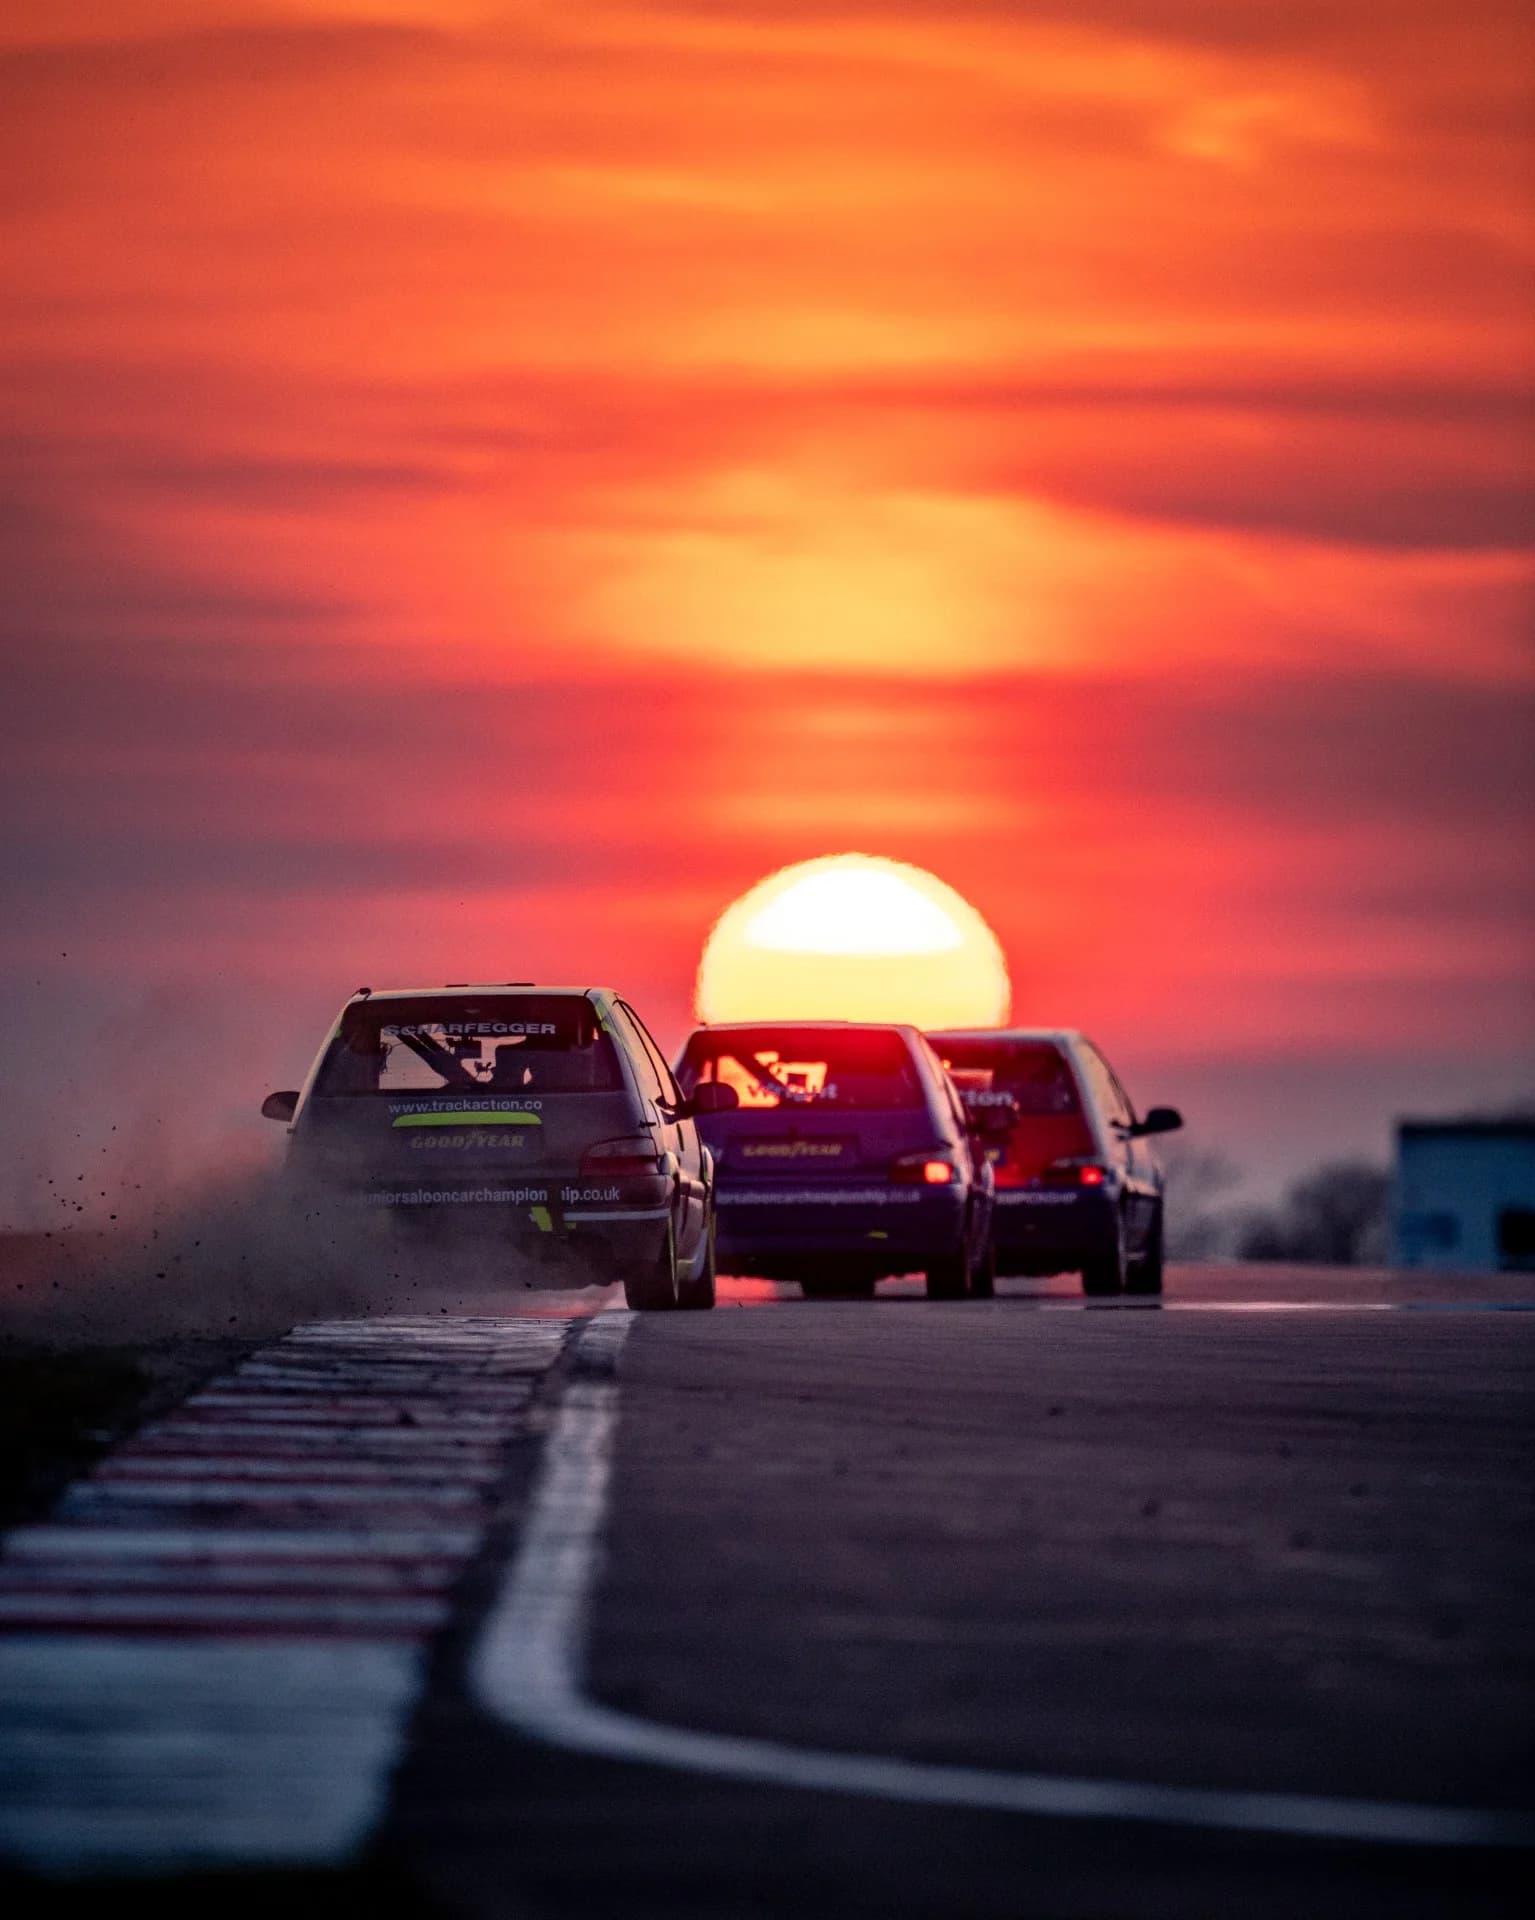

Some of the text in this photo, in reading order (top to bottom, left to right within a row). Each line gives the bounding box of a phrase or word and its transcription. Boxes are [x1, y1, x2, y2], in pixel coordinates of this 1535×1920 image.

[383, 1022, 557, 1036] SCHARFEGGER
[387, 1098, 544, 1114] www.trackaction.co
[411, 1133, 525, 1149] GOODYEAR
